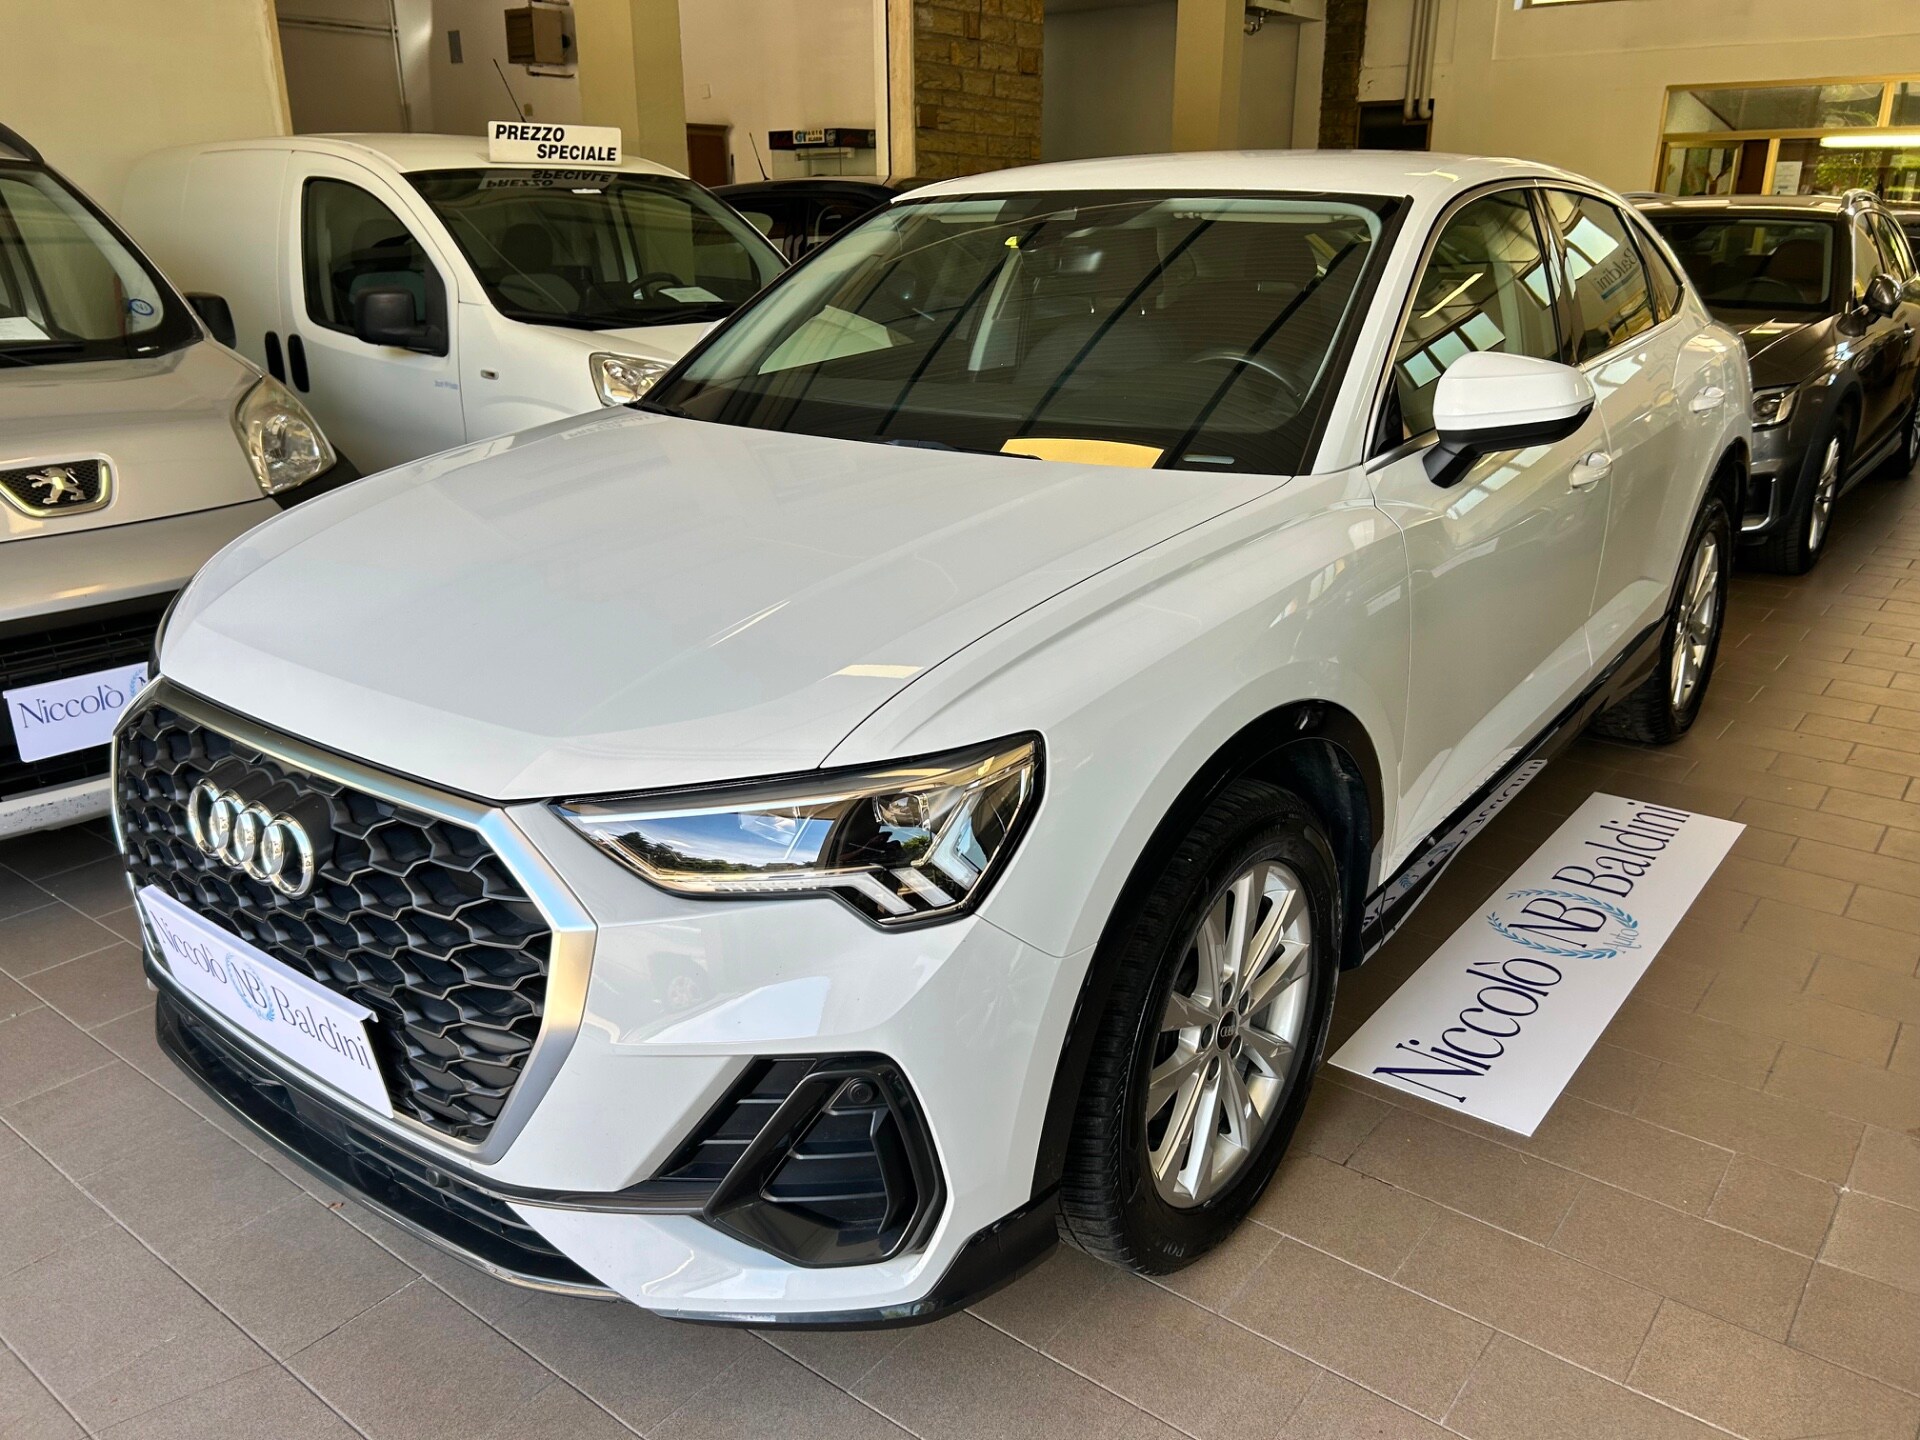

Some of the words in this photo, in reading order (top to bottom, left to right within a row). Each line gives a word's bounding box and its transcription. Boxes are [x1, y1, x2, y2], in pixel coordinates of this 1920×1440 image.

[495, 124, 565, 142] PREZZO
[536, 143, 617, 161] SPECIALE
[17, 684, 125, 729] Niccolò
[1551, 801, 1691, 898] Baldini
[1507, 897, 1607, 948] NB
[1602, 928, 1642, 954] Auto
[149, 910, 228, 984] Niccolò
[230, 961, 267, 1009] NB
[270, 985, 372, 1070] Baldini
[1372, 957, 1562, 1104] Niccolò
